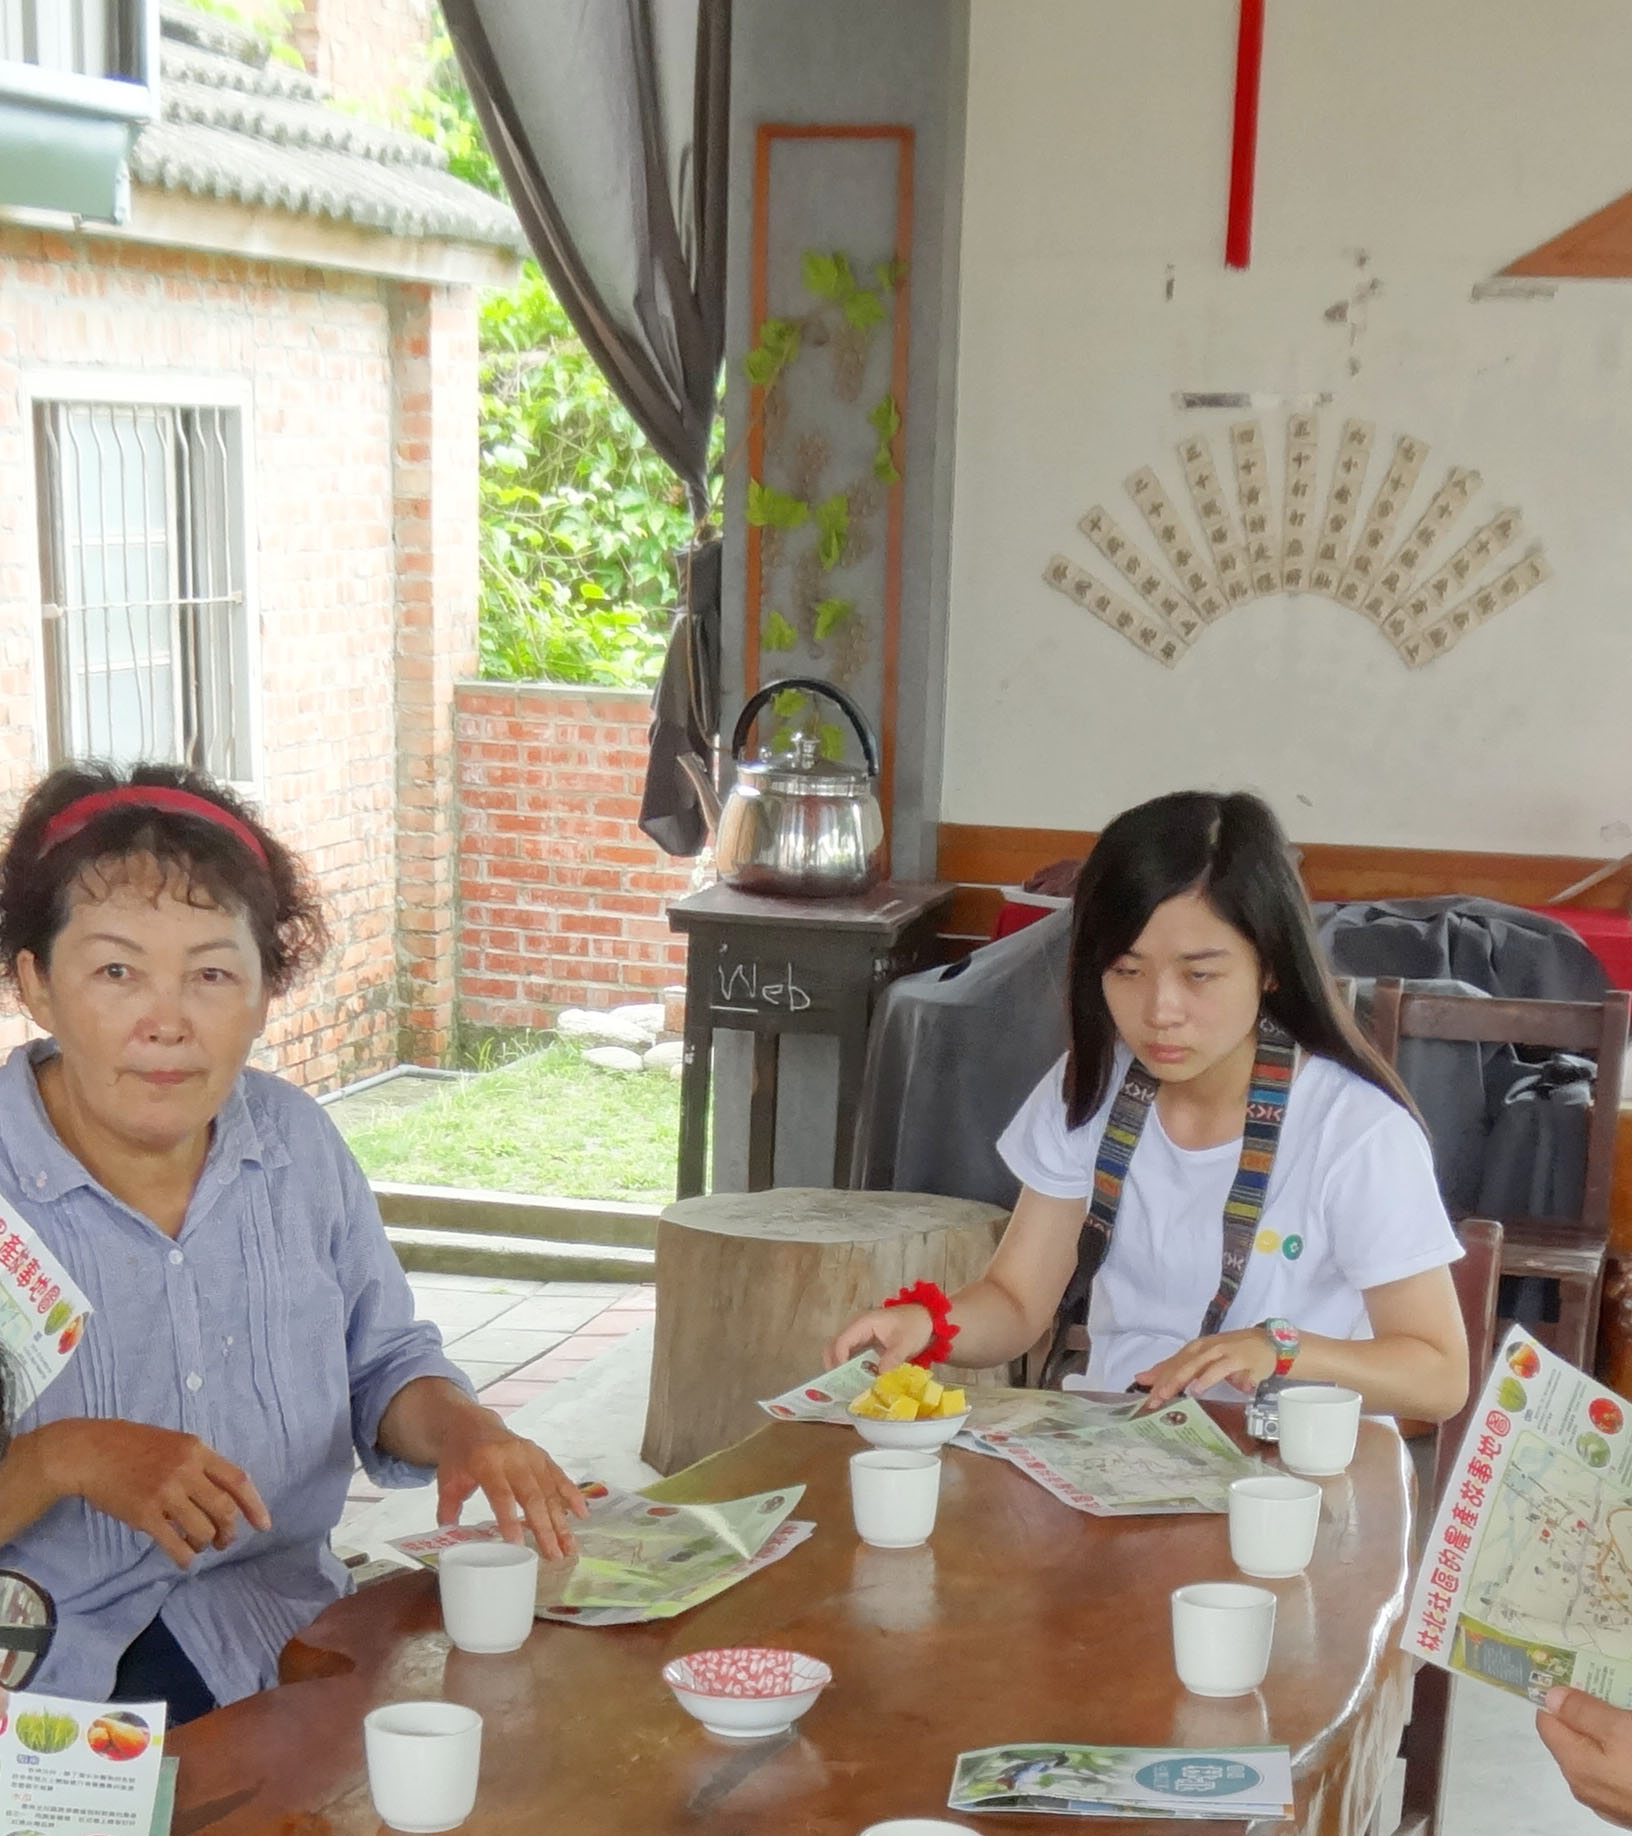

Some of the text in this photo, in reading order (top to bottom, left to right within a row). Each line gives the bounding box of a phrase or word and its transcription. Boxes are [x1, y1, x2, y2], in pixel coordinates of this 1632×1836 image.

[718, 961, 811, 1012] Web
[1415, 1409, 1512, 1653] 林北社區的農產故事地圖
